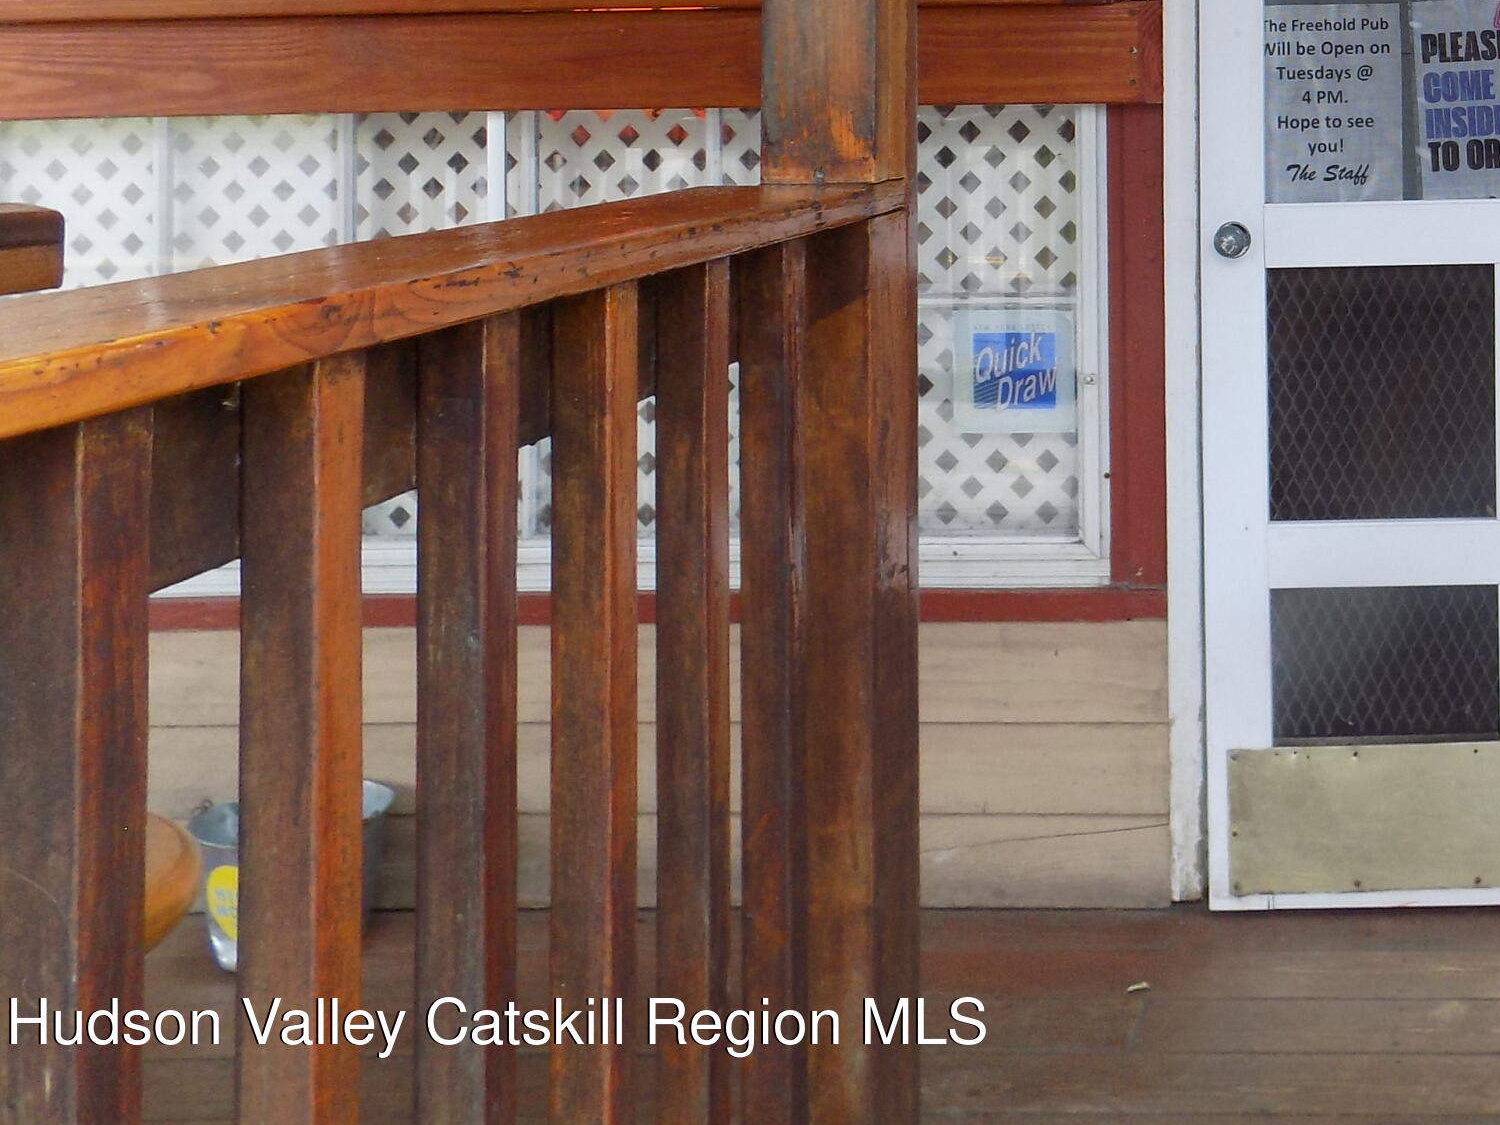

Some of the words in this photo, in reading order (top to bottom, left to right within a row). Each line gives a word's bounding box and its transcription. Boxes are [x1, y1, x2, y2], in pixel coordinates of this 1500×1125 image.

[1292, 18, 1355, 31] Freehold
[1361, 18, 1389, 30] Pub
[1297, 42, 1316, 55] be
[1321, 42, 1364, 57] Open
[1370, 43, 1390, 54] on
[1276, 66, 1351, 82] Tuesdays
[1357, 65, 1373, 81] @
[1423, 69, 1495, 103] COME
[1302, 90, 1311, 104] 4
[1317, 90, 1348, 104] PM.
[1277, 116, 1320, 131] Hope
[1325, 116, 1342, 128] to
[1347, 117, 1374, 128] see
[1308, 139, 1344, 156] you!
[1428, 140, 1460, 172] TO
[1286, 164, 1316, 182] The
[1323, 164, 1369, 185] Staff
[976, 331, 1042, 382] Quick
[997, 366, 1057, 411] Draw
